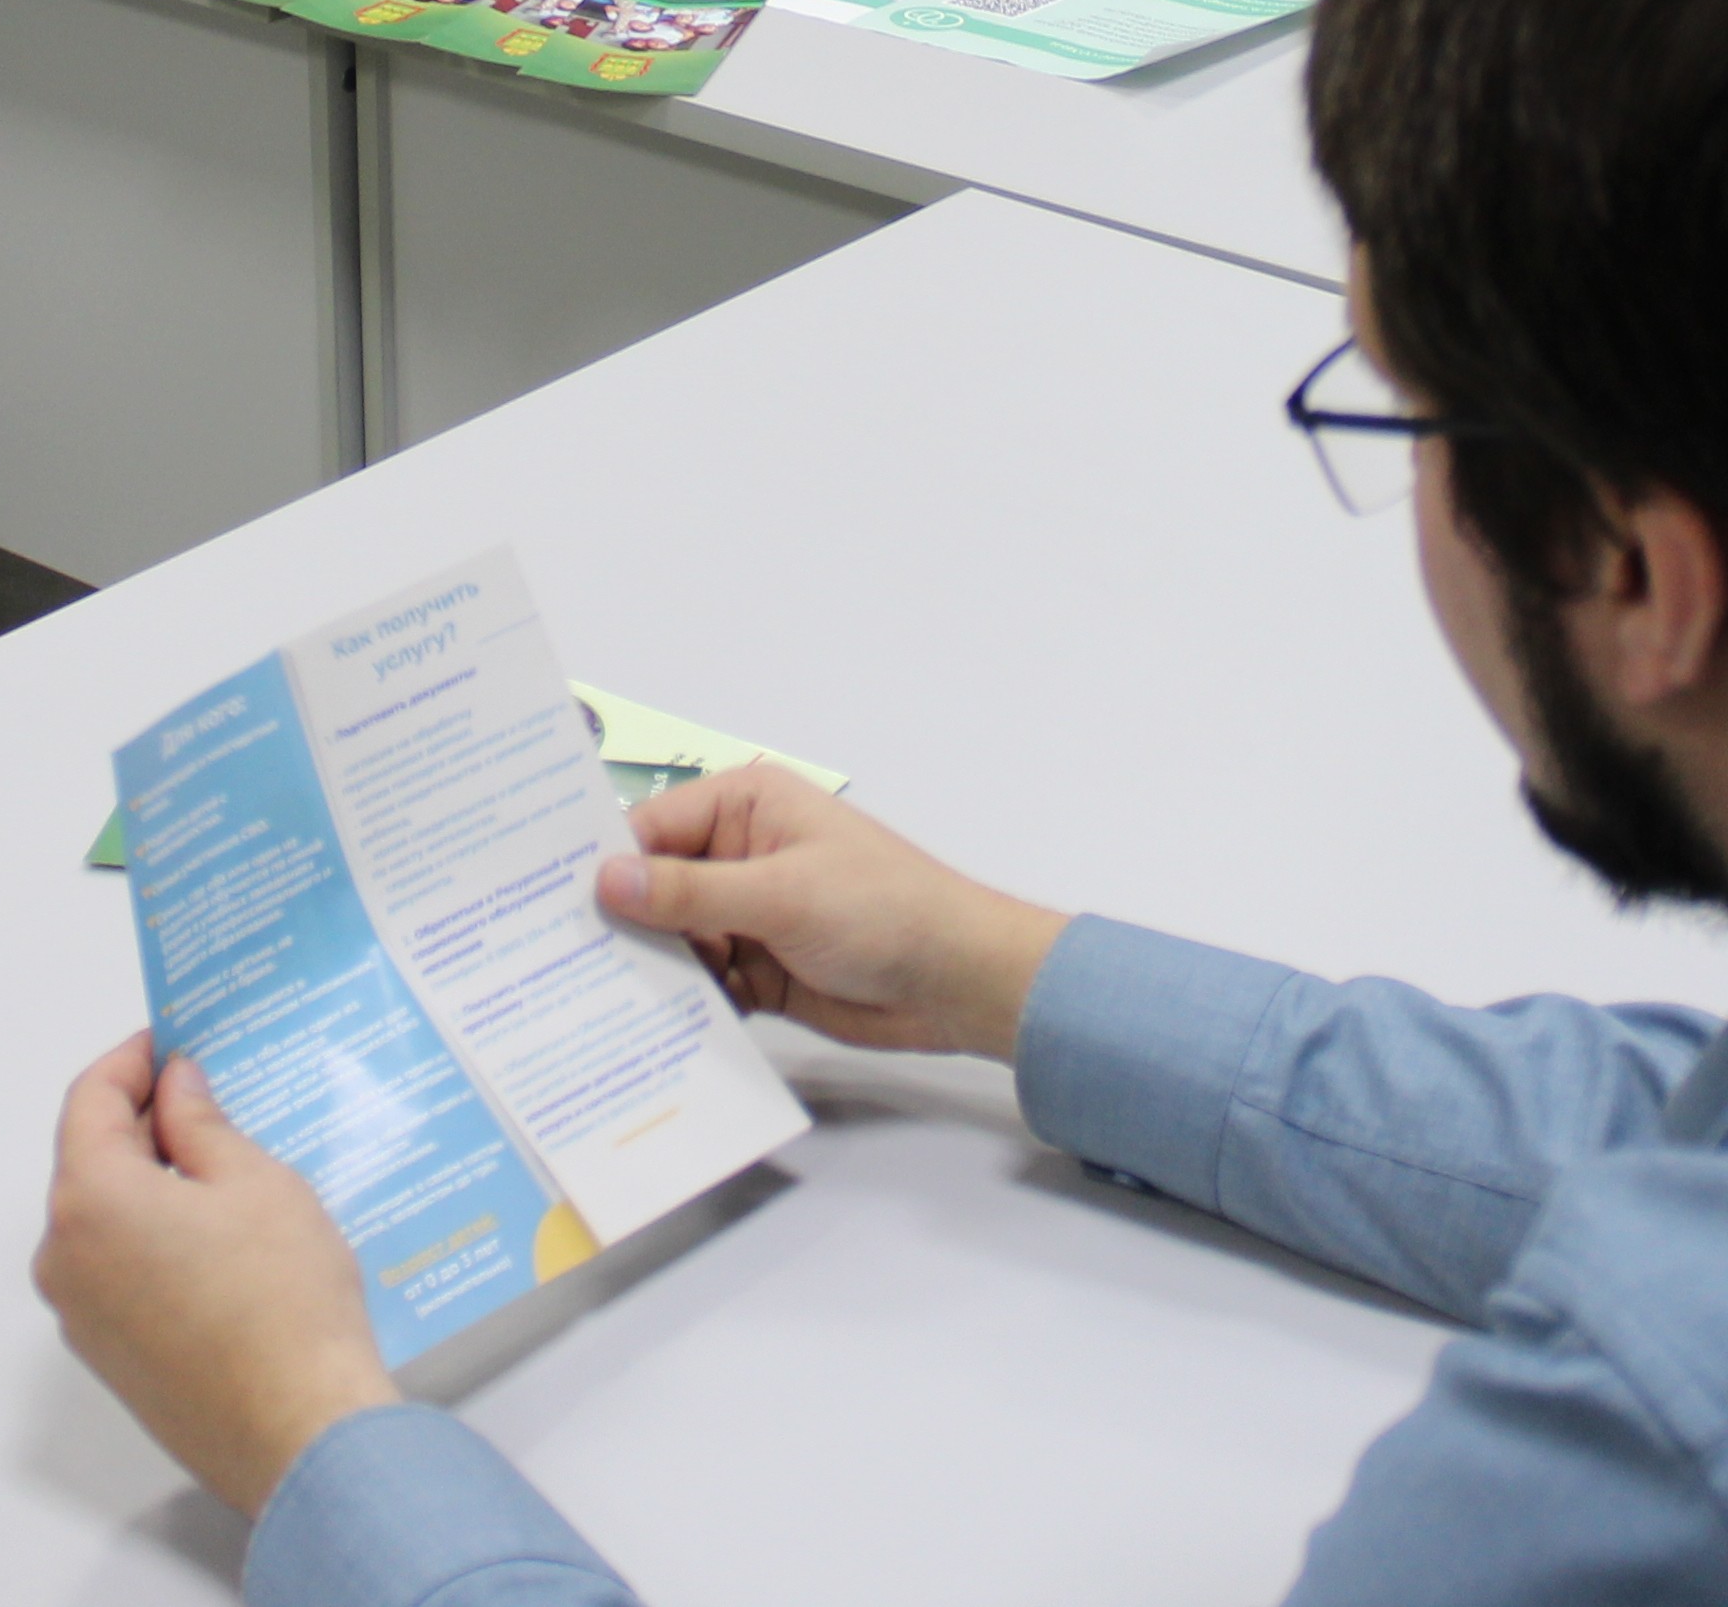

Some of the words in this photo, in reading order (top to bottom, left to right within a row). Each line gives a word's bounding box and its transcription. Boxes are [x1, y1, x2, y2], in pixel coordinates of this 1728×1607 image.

[331, 632, 371, 658] Как
[377, 584, 478, 635] получить
[374, 623, 455, 681] услугу?
